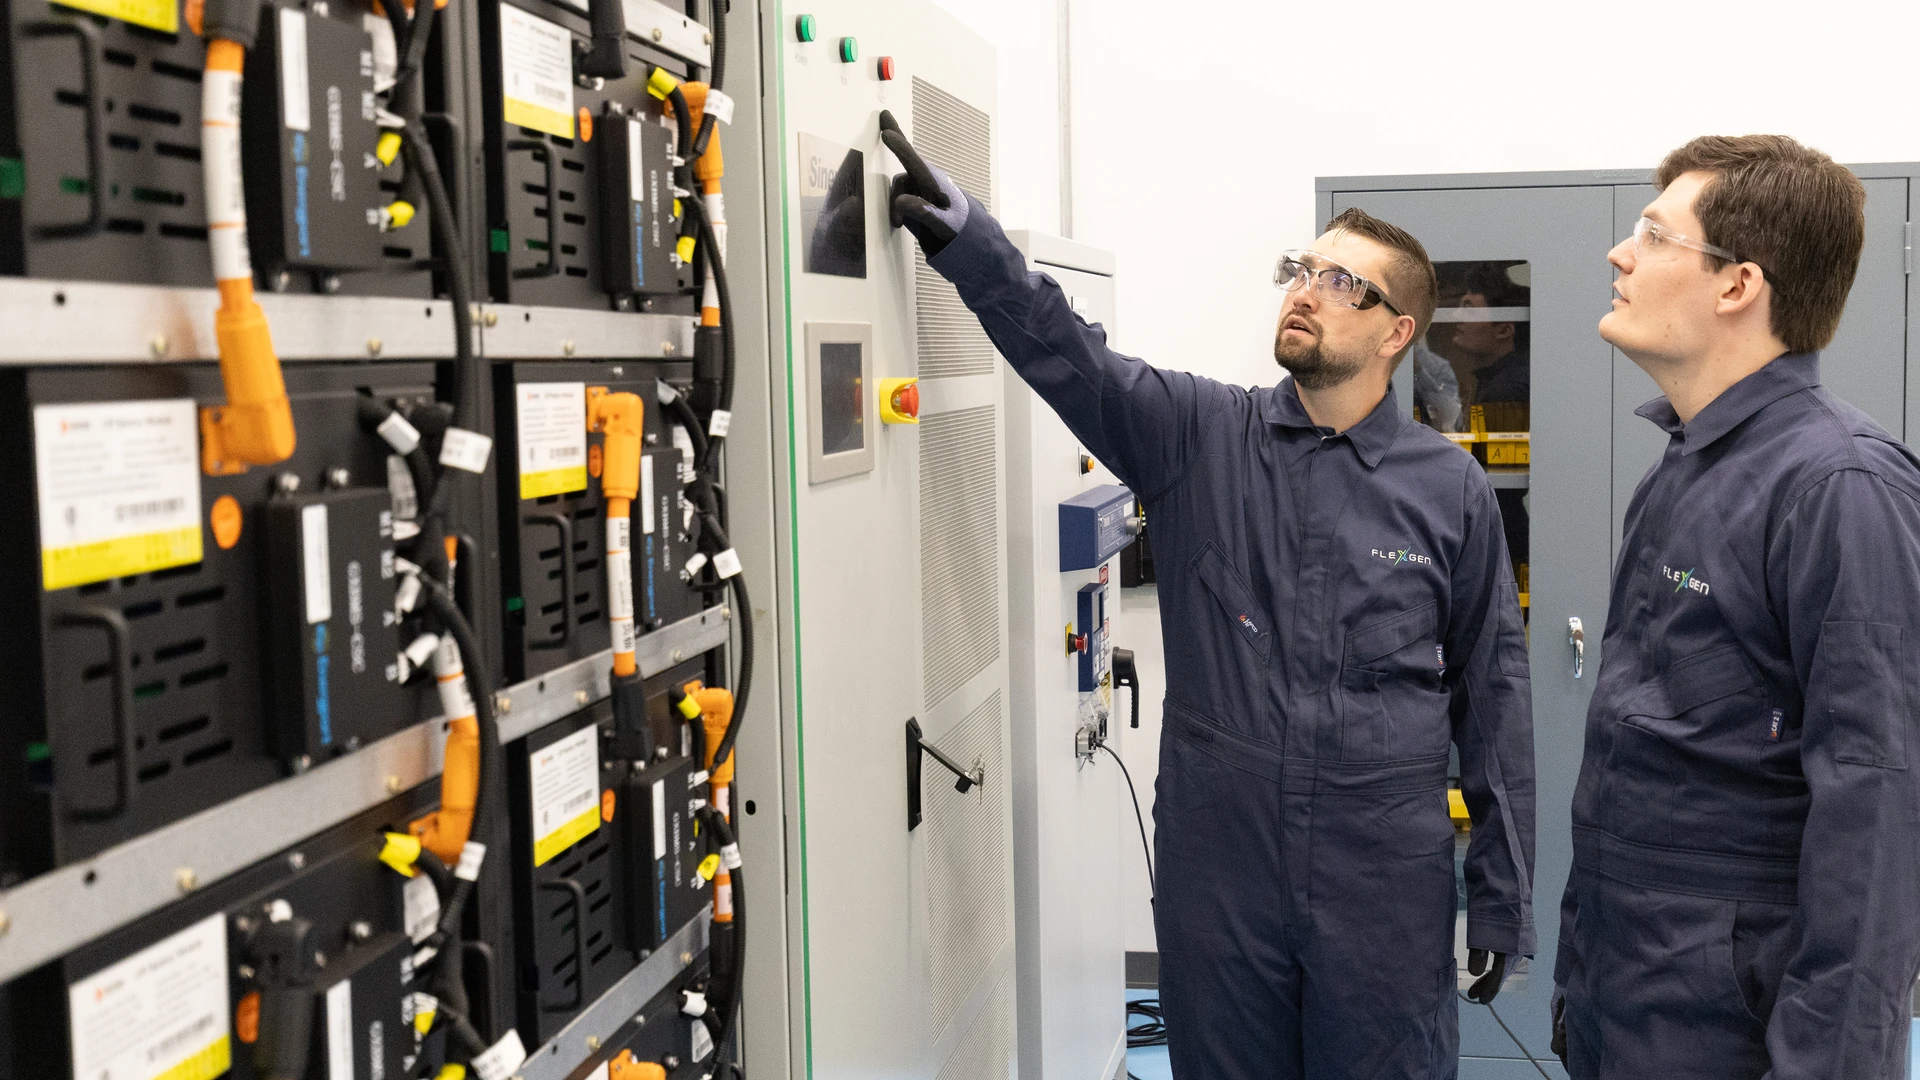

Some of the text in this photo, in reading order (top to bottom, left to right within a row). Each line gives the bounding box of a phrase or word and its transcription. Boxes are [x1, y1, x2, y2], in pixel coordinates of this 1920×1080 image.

[1492, 448, 1501, 459] A
[1371, 546, 1432, 566] FLEXGEN
[1663, 565, 1710, 596] FLEXGEN
[1771, 721, 1779, 732] CAT
